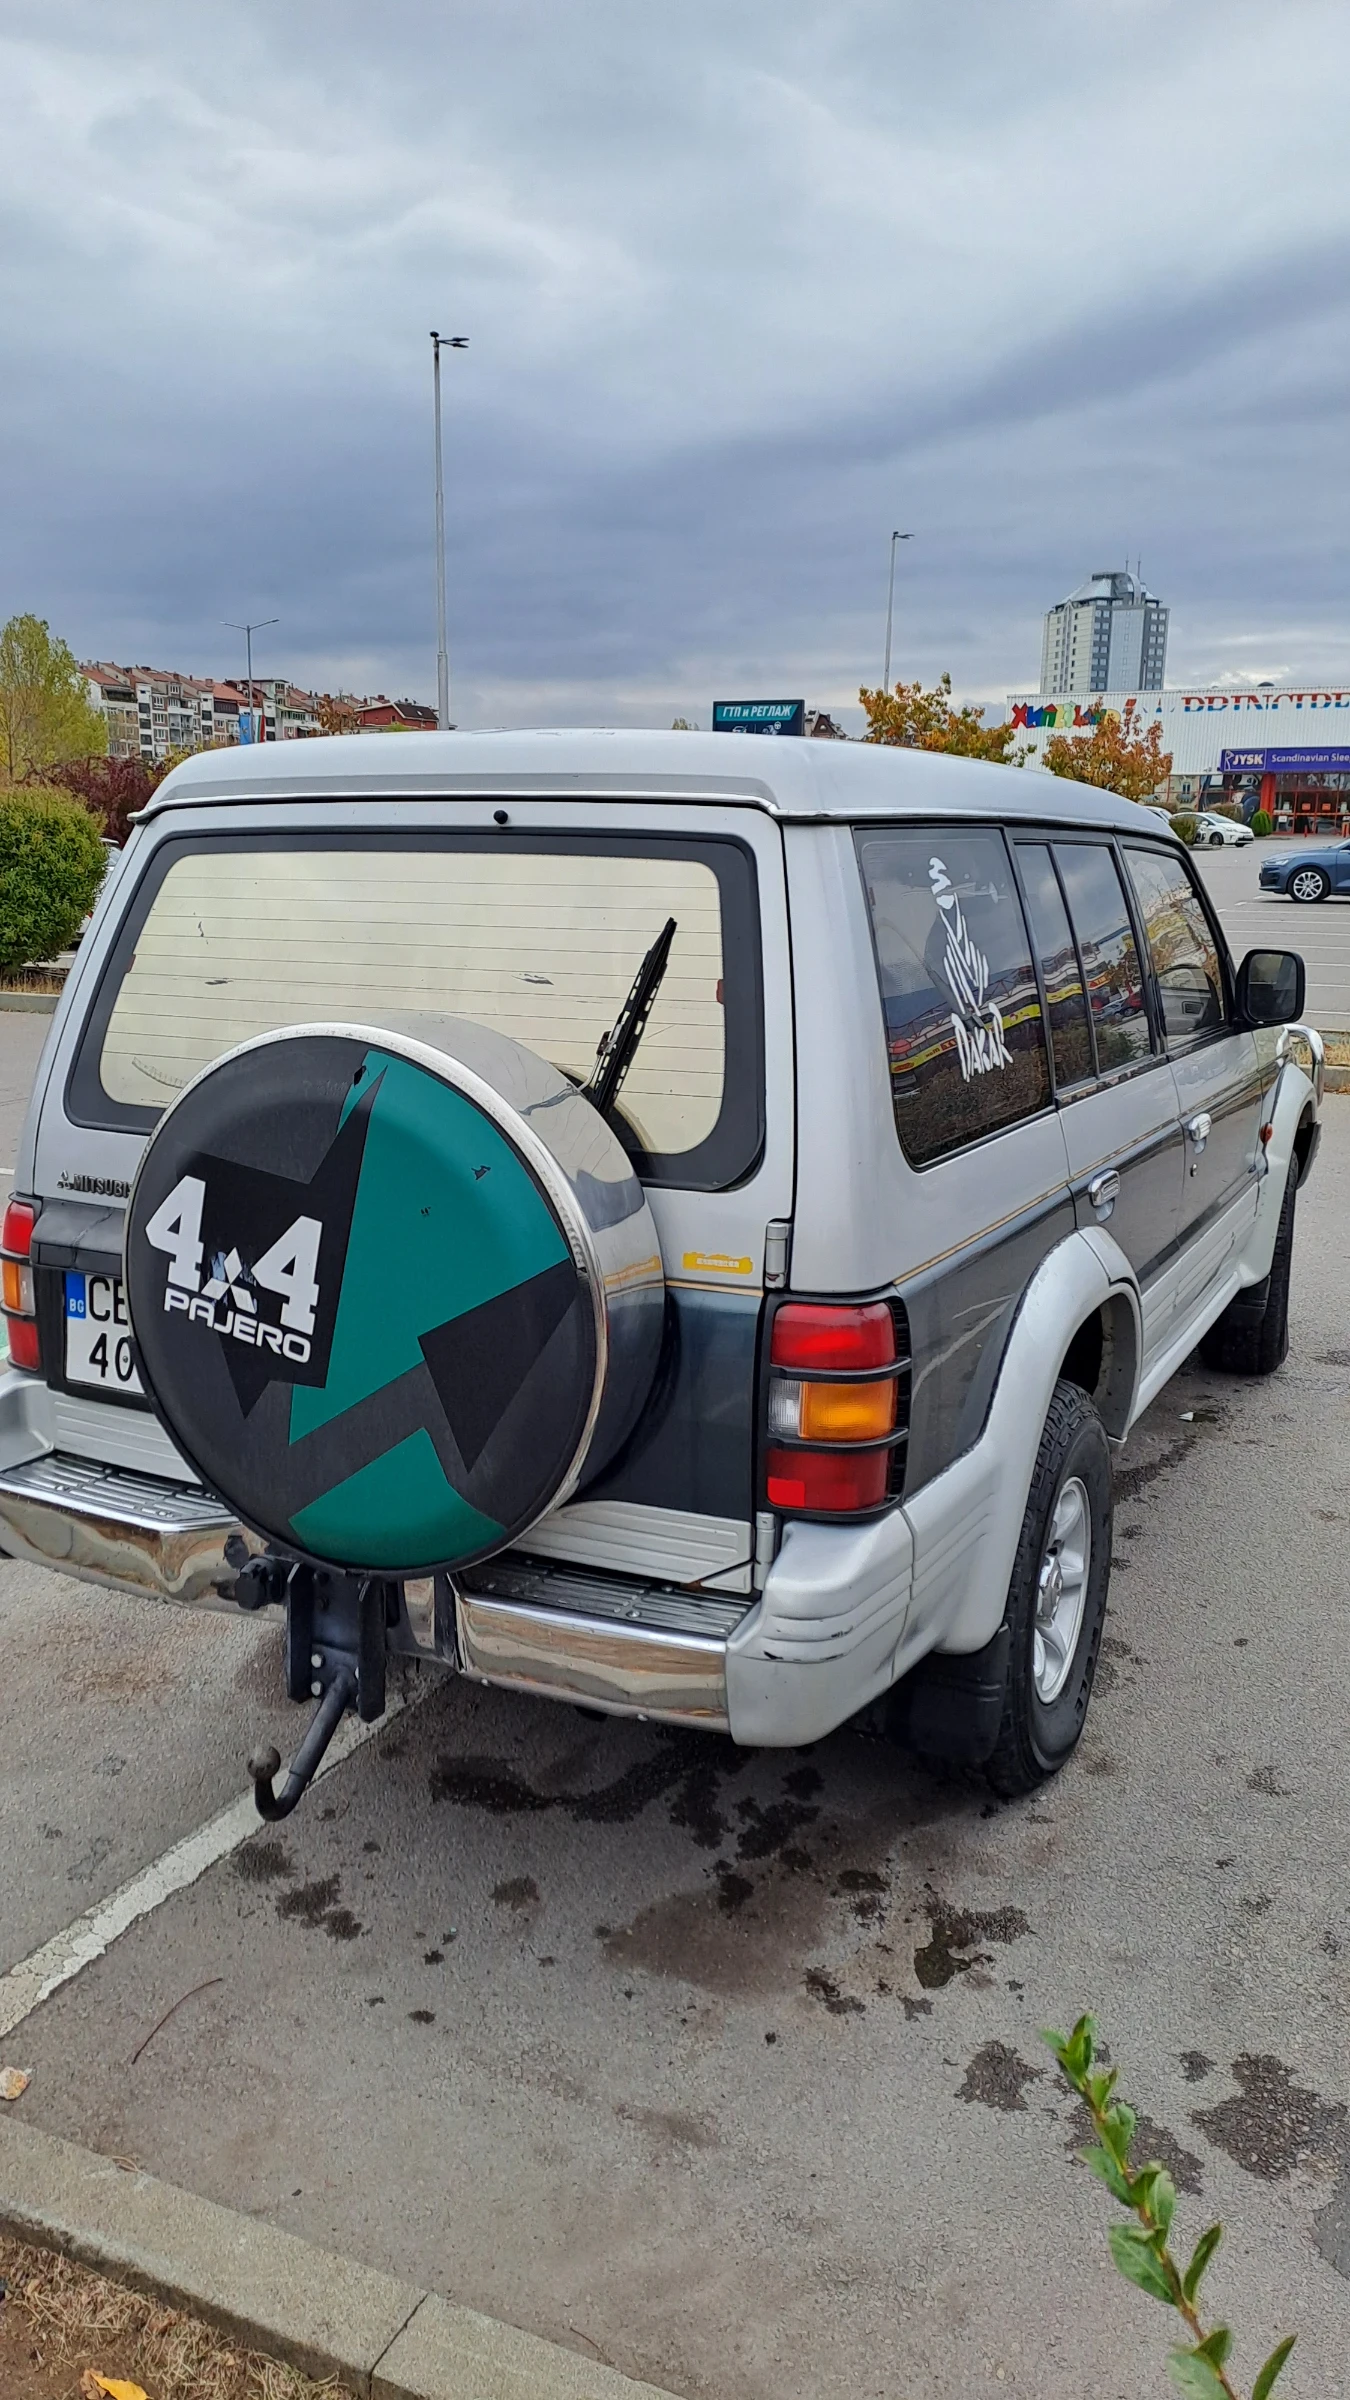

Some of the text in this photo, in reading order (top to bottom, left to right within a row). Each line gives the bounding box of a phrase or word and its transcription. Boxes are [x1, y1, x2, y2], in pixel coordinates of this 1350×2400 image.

[722, 706, 741, 717] ГТП
[750, 704, 792, 717] РЕГЛАЖ
[1232, 752, 1350, 766] JYSK Scandinavian Slee
[73, 1173, 132, 1198] MITSUBI
[69, 1298, 85, 1313] BG
[164, 1287, 311, 1363] PAJERO
[88, 1332, 135, 1382] 40
